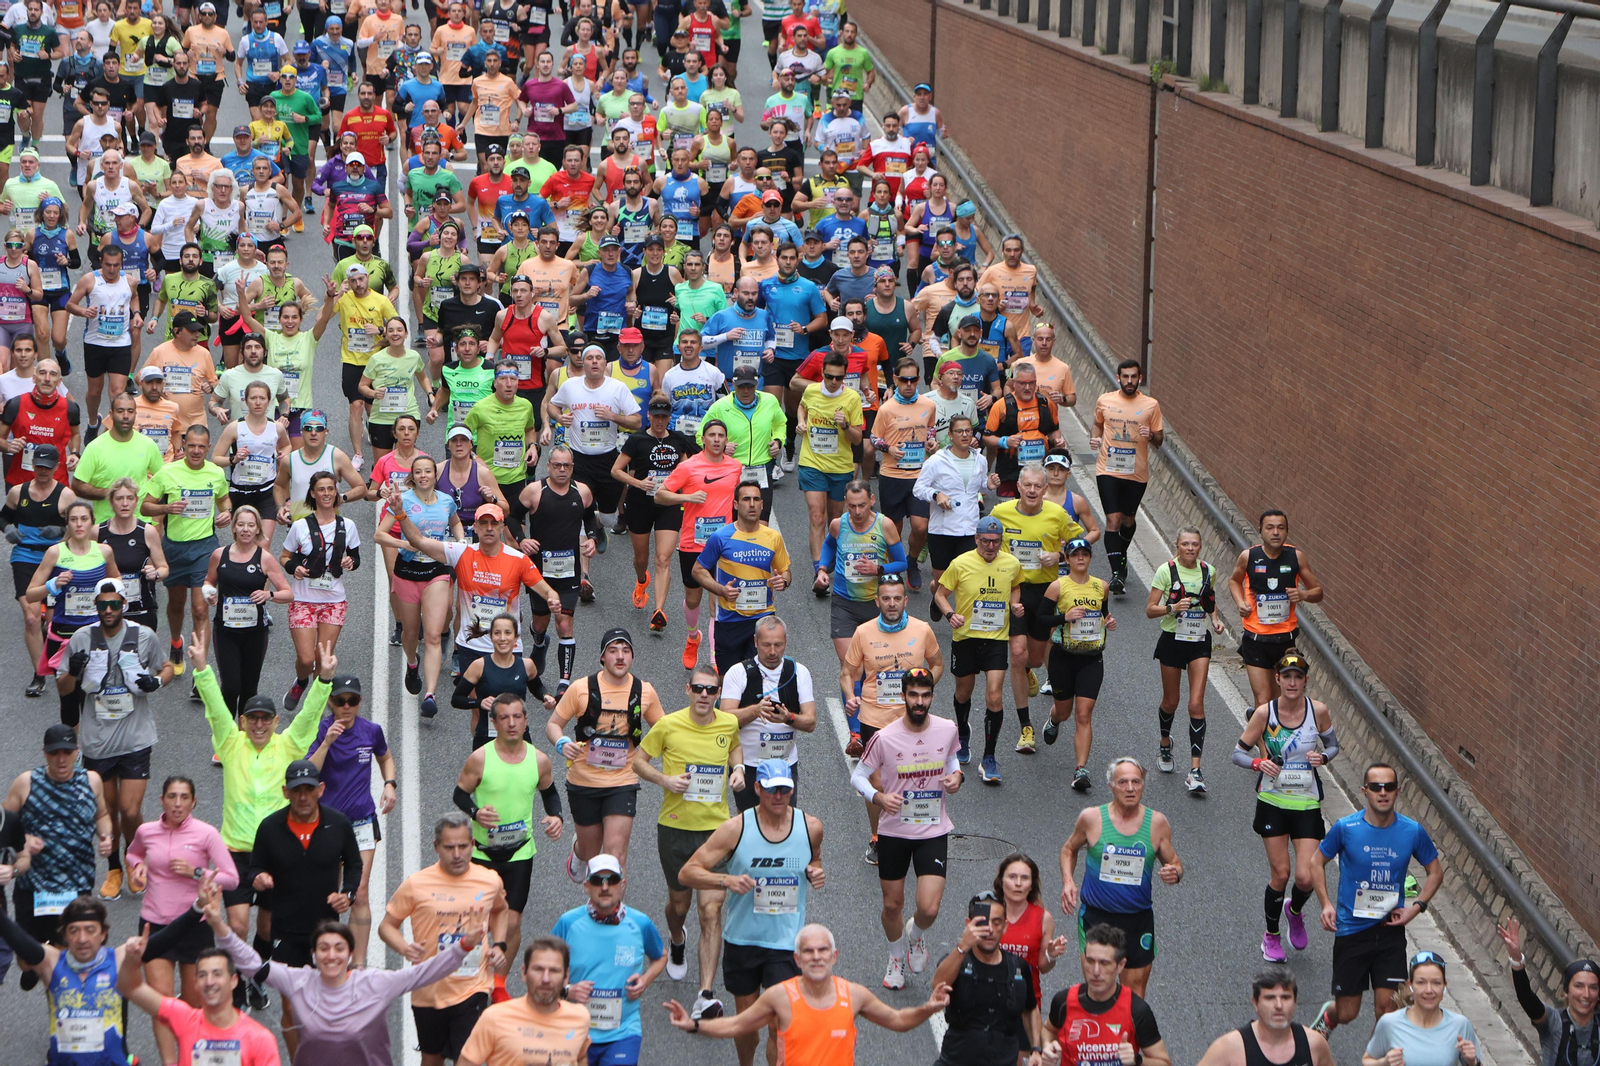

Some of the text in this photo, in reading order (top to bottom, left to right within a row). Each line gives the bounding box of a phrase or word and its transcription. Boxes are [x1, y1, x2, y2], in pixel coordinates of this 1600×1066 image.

[456, 380, 479, 388] sano
[29, 424, 54, 433] vicenza
[29, 429, 54, 438] runners
[649, 452, 679, 462] Chicago
[733, 549, 771, 563] agustinos
[472, 577, 501, 586] MARATHON
[1073, 597, 1097, 606] teika
[897, 760, 945, 774] MADRID
[1118, 847, 1141, 856] ZURICH
[1115, 859, 1130, 867] 9793
[1371, 883, 1395, 891] ZURICH
[592, 989, 618, 998] ZURICH
[1077, 1042, 1119, 1053] vicenza
